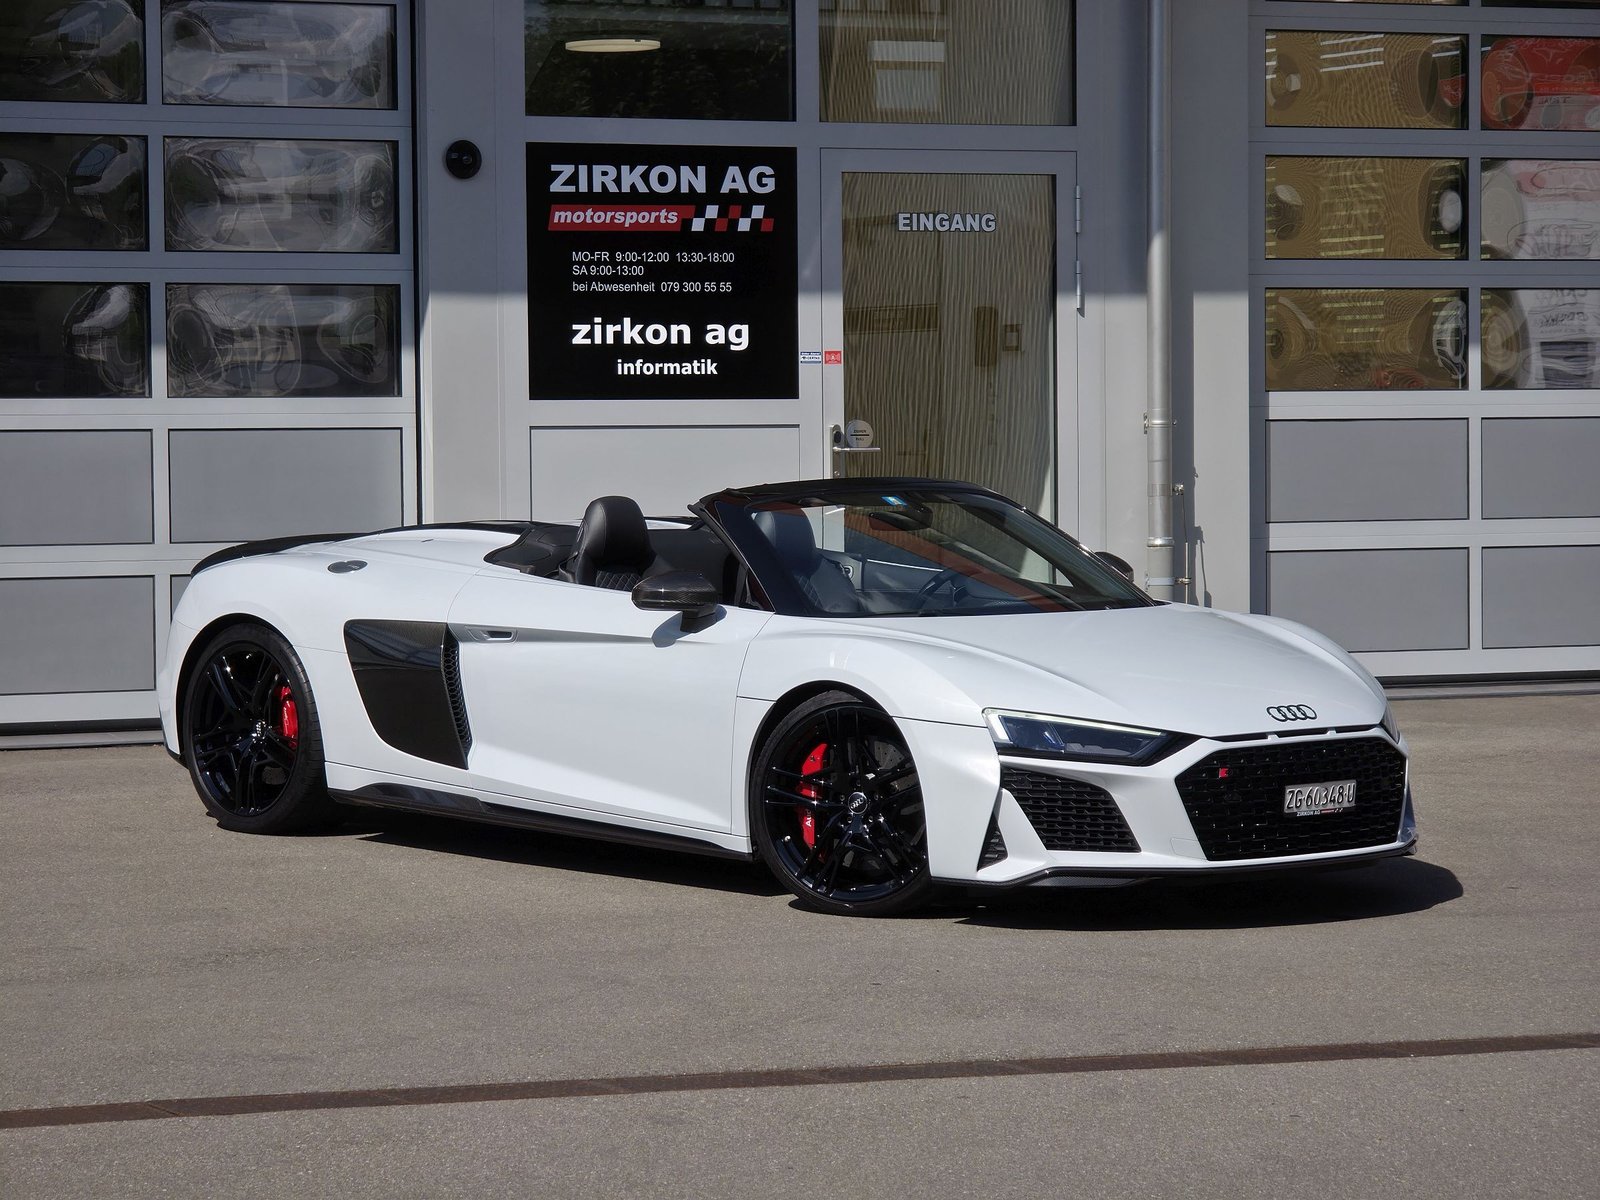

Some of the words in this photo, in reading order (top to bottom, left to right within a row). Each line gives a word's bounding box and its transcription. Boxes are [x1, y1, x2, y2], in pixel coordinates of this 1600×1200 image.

[549, 164, 706, 194] ZIRKON
[719, 165, 776, 194] AG
[553, 208, 678, 228] motorsports
[897, 212, 996, 232] EINGANG
[572, 251, 610, 263] MO-FR
[615, 251, 670, 263] 9:00-12:00
[675, 251, 735, 263] 13:30-18:00
[572, 265, 588, 276] SA
[589, 265, 645, 277] 9:00-13:00
[572, 281, 588, 292] bei
[589, 281, 656, 293] Abwesenheit
[660, 281, 680, 293] 079
[682, 281, 702, 293] 300
[703, 282, 718, 293] 55
[719, 282, 733, 293] 55
[571, 316, 691, 345] zirkon
[705, 323, 750, 351] ag
[617, 358, 718, 376] informatik
